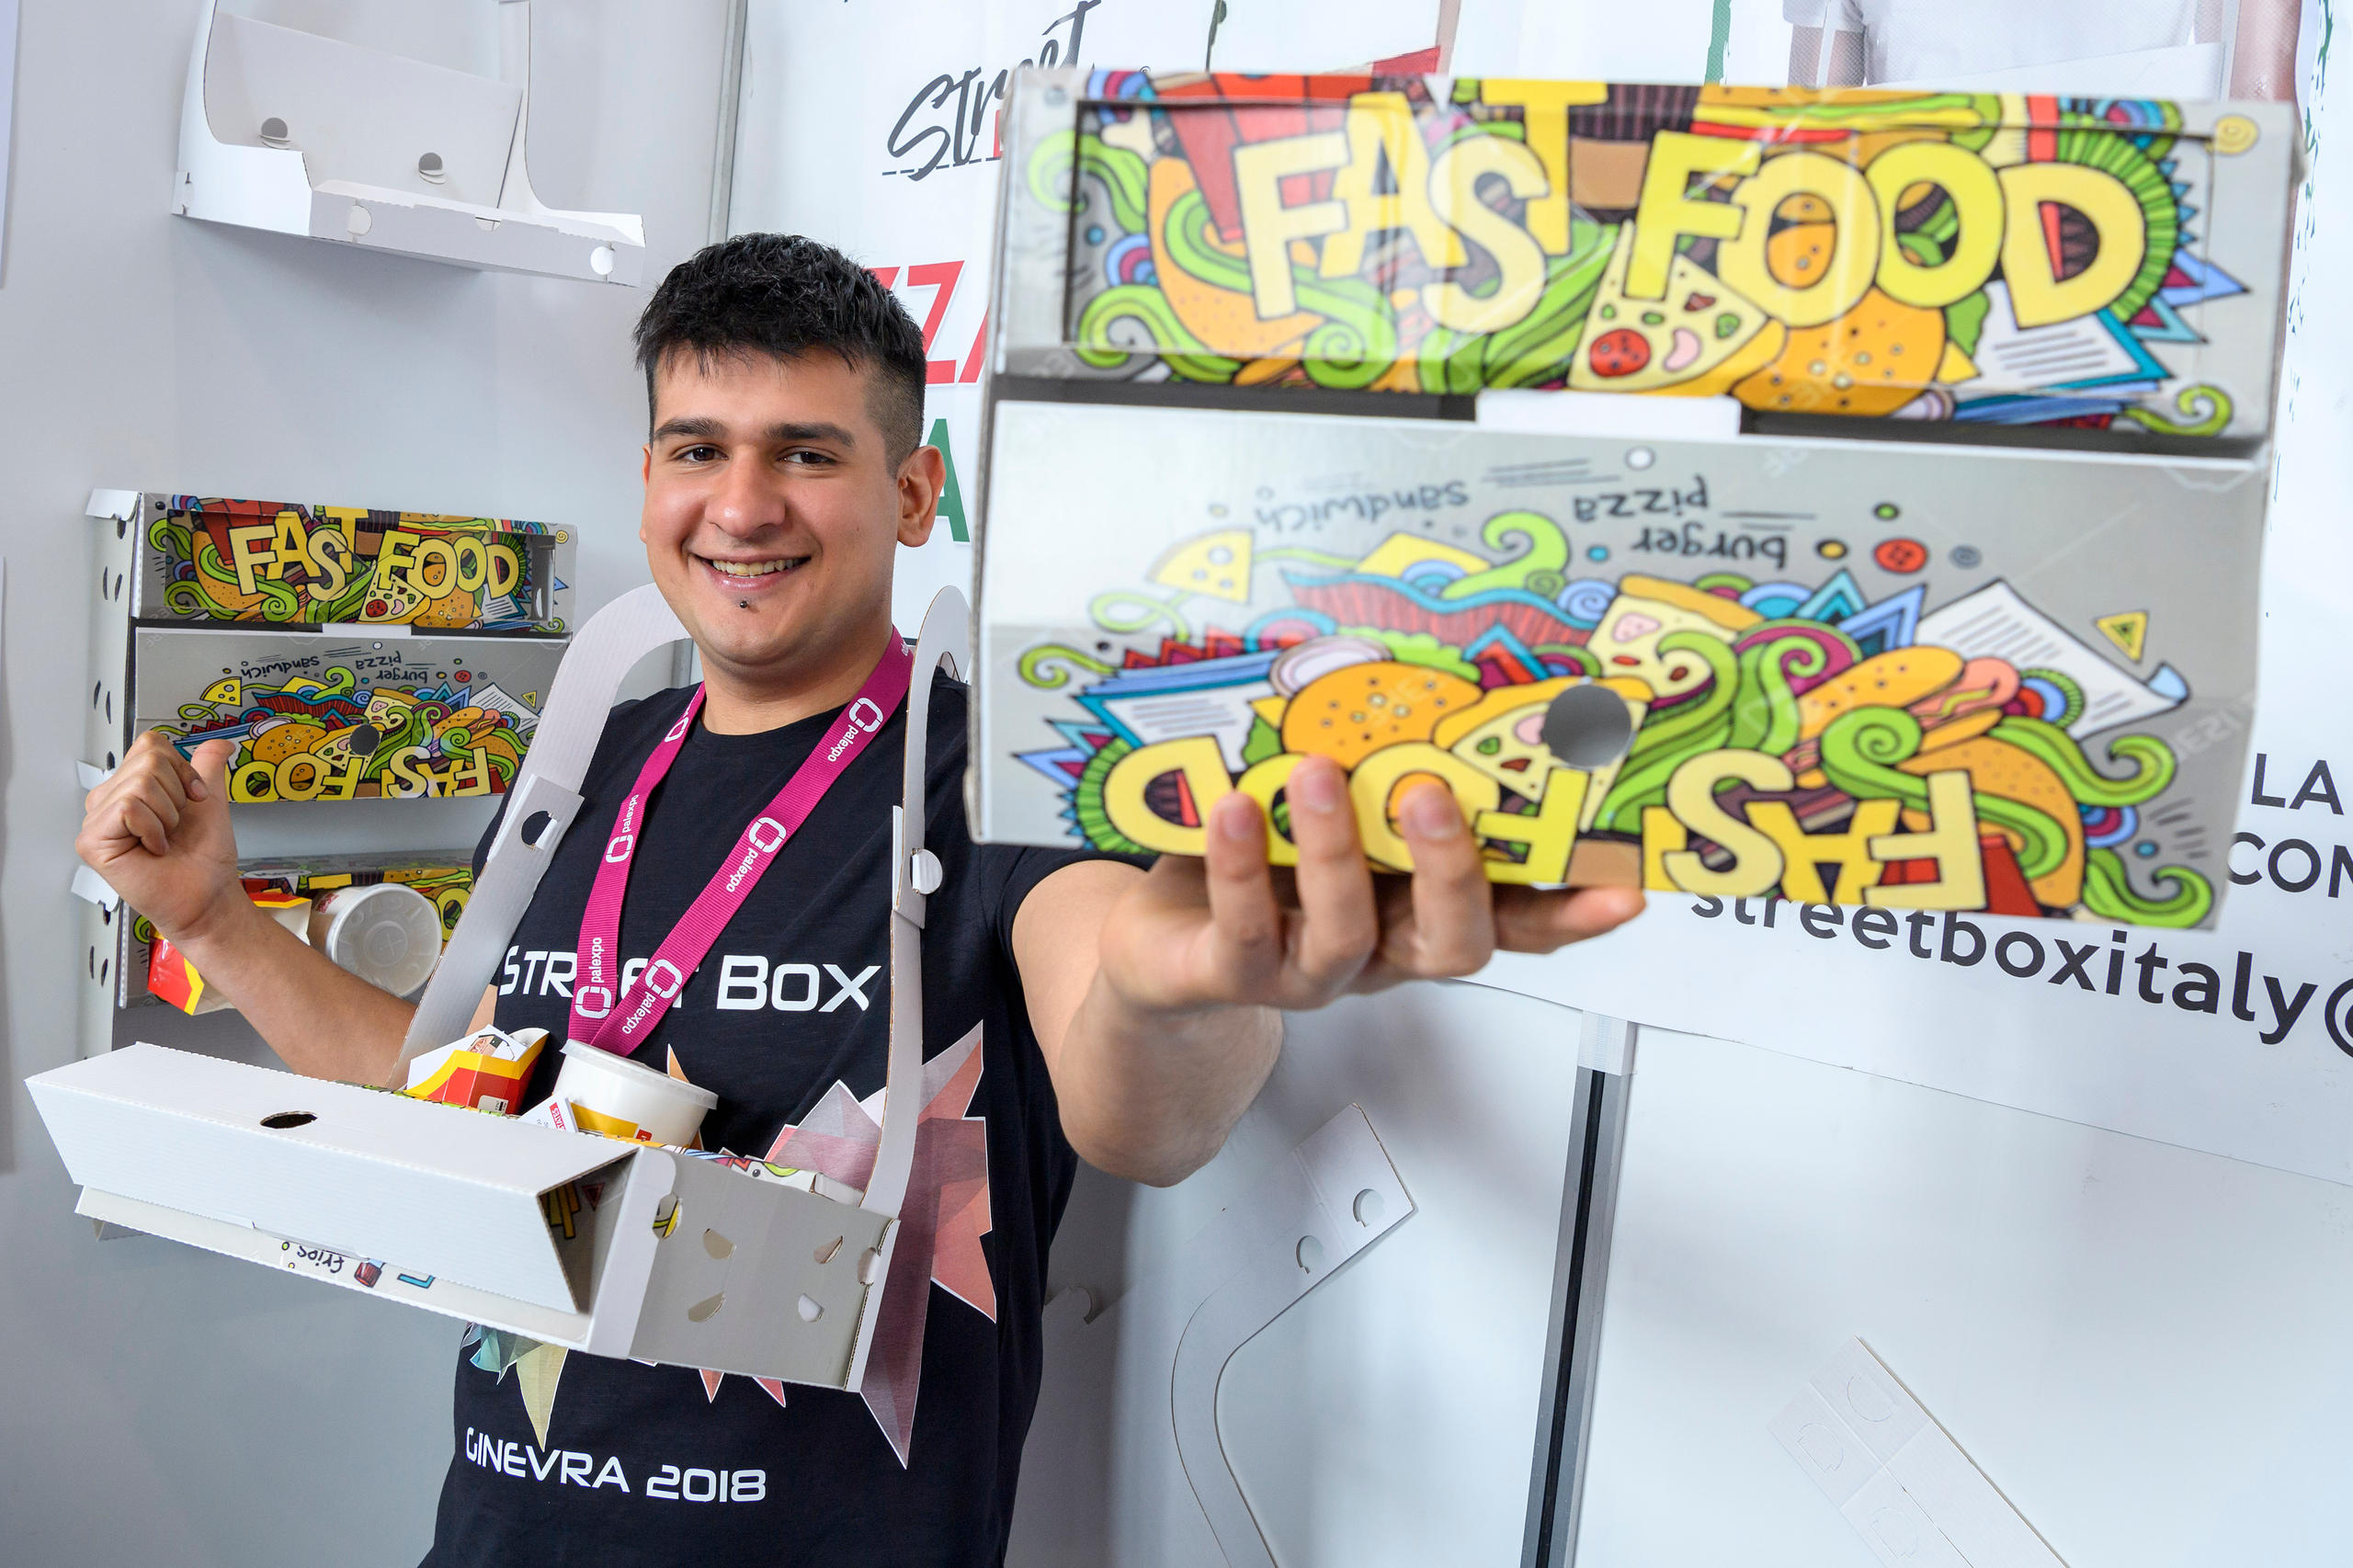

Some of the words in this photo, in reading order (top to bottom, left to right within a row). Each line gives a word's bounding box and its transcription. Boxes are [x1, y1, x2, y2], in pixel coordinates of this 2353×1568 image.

[887, 0, 1101, 182] Strt
[1233, 77, 1608, 334] FAST
[1623, 129, 2149, 329] FOOD
[1256, 481, 1469, 533] sandwich
[1573, 473, 1709, 523] pizza
[228, 505, 369, 601] FAST
[377, 529, 521, 599] FOOD
[1631, 521, 1788, 571] burger
[241, 655, 321, 679] sandwich
[356, 651, 403, 670] pizza
[375, 667, 428, 684] burger
[827, 724, 859, 762] palexpo
[227, 752, 366, 804] FOO
[2251, 753, 2345, 815] LA
[621, 794, 640, 834] palexpo
[726, 847, 759, 892] palexpo
[590, 937, 603, 983] palexpo
[621, 992, 657, 1036] palexpo
[297, 1244, 345, 1274] fries
[466, 1426, 631, 1494] GINEVRA
[646, 1464, 766, 1503] 2018
